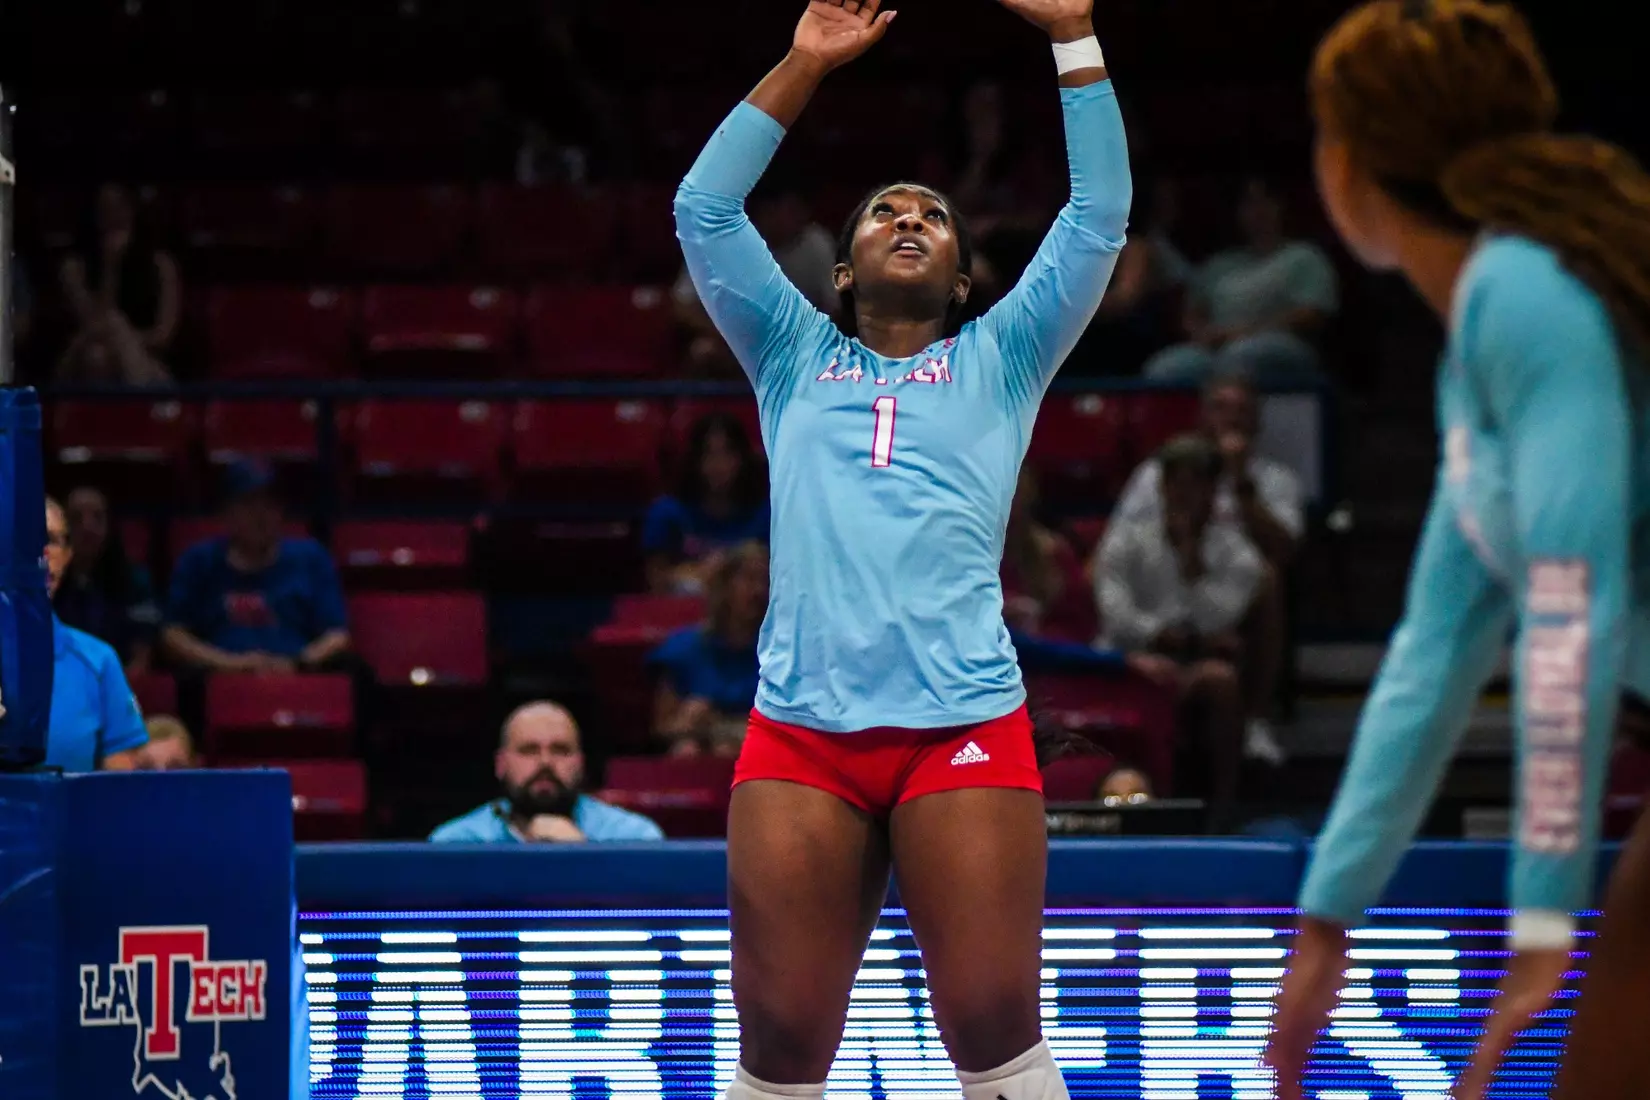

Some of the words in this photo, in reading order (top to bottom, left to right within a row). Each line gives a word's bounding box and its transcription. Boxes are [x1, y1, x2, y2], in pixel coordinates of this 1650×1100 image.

[871, 395, 897, 468] 1
[951, 753, 990, 766] adidas
[299, 930, 1459, 1100] ARNRS
